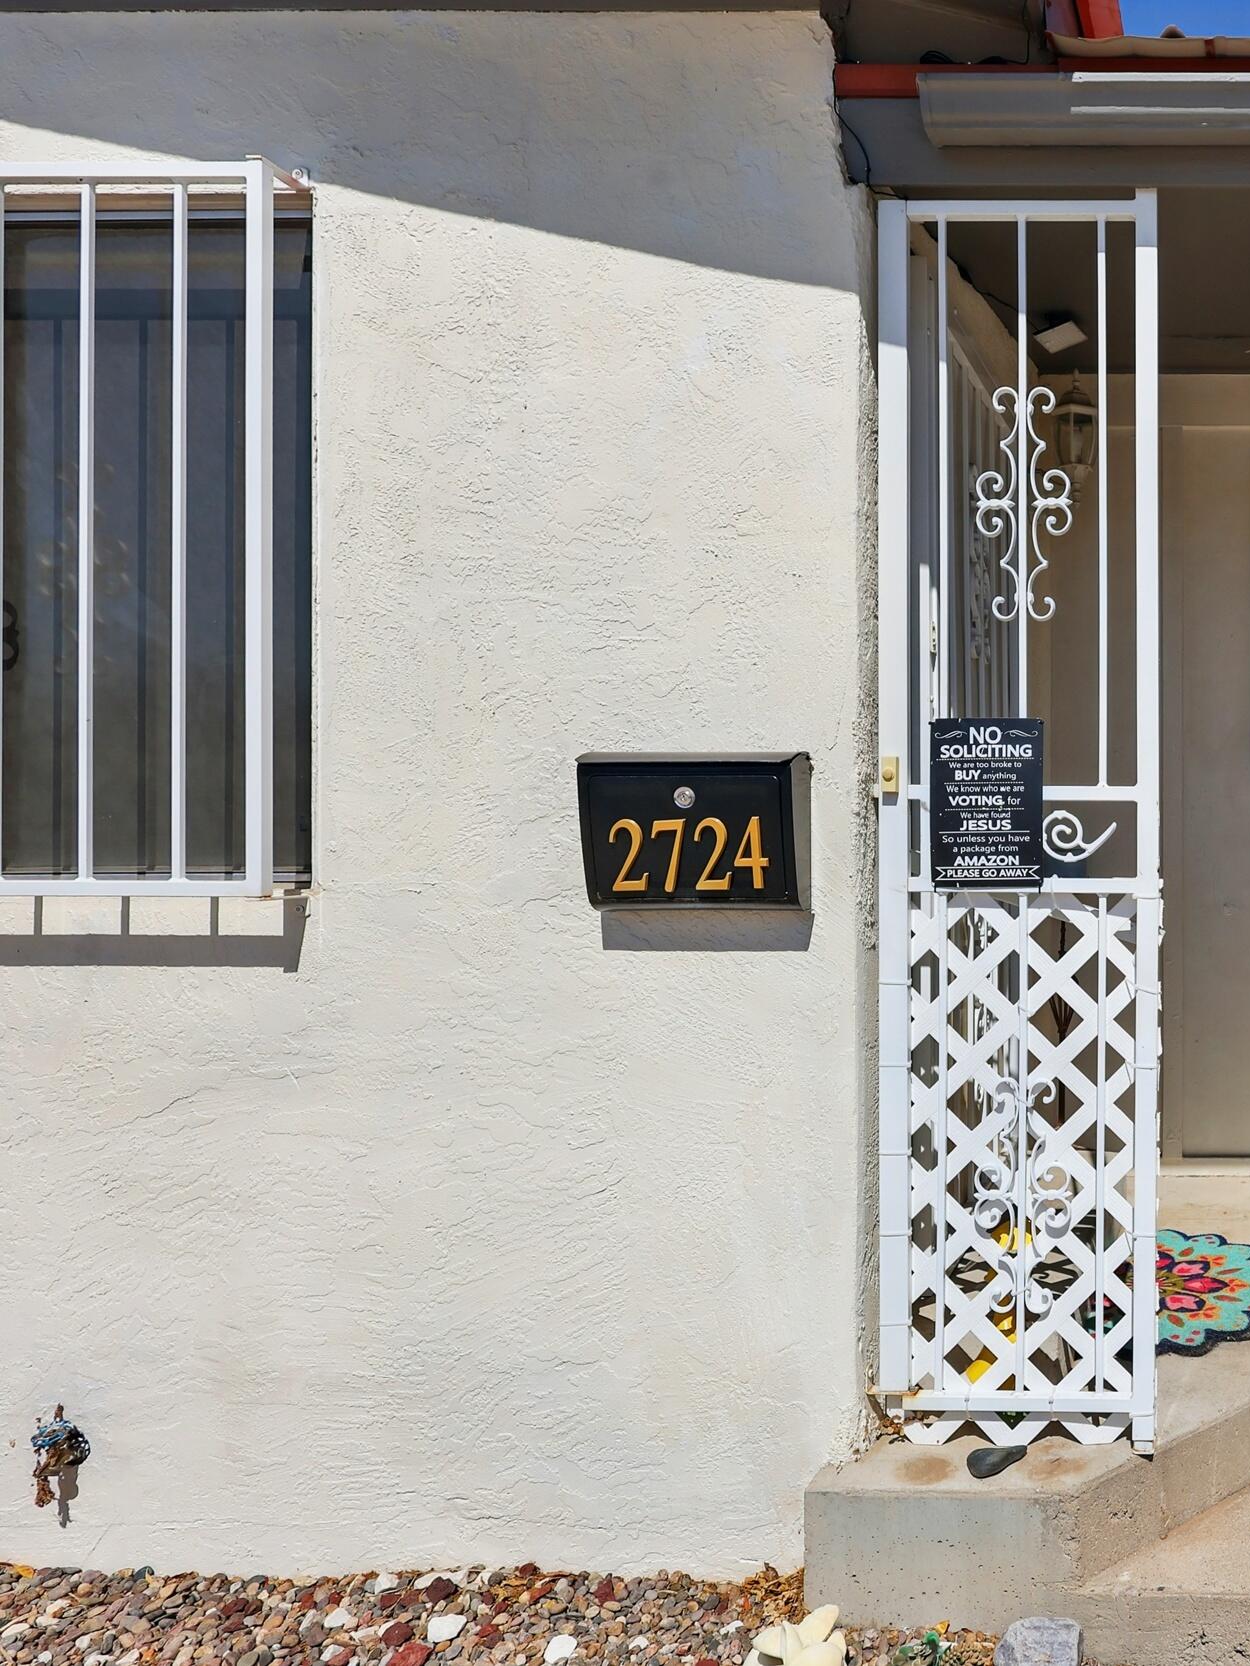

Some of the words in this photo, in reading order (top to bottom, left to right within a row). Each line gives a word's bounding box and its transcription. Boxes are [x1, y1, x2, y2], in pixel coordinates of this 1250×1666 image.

[969, 726, 1002, 744] NO
[940, 744, 1033, 758] SOLICITING
[991, 760, 1012, 768] broke
[955, 770, 981, 781] BUY
[983, 771, 1016, 781] anything
[946, 785, 958, 793] We
[961, 784, 980, 792] know
[983, 784, 998, 792] who
[1013, 784, 1025, 792] are
[949, 795, 1004, 806] VOTING
[1007, 796, 1021, 805] for
[973, 811, 989, 819] have
[991, 811, 1011, 819] found
[960, 820, 1012, 831] JESUS
[942, 835, 954, 843] So
[957, 834, 986, 843] unless
[988, 834, 1006, 845] you
[1008, 834, 1030, 842] have
[608, 816, 769, 893] 2724
[960, 845, 996, 854] package
[998, 844, 1019, 852] from
[954, 855, 1020, 866] AMAZON
[946, 869, 980, 878] PLEASE
[982, 868, 997, 877] GO
[999, 868, 1029, 877] AWAY
